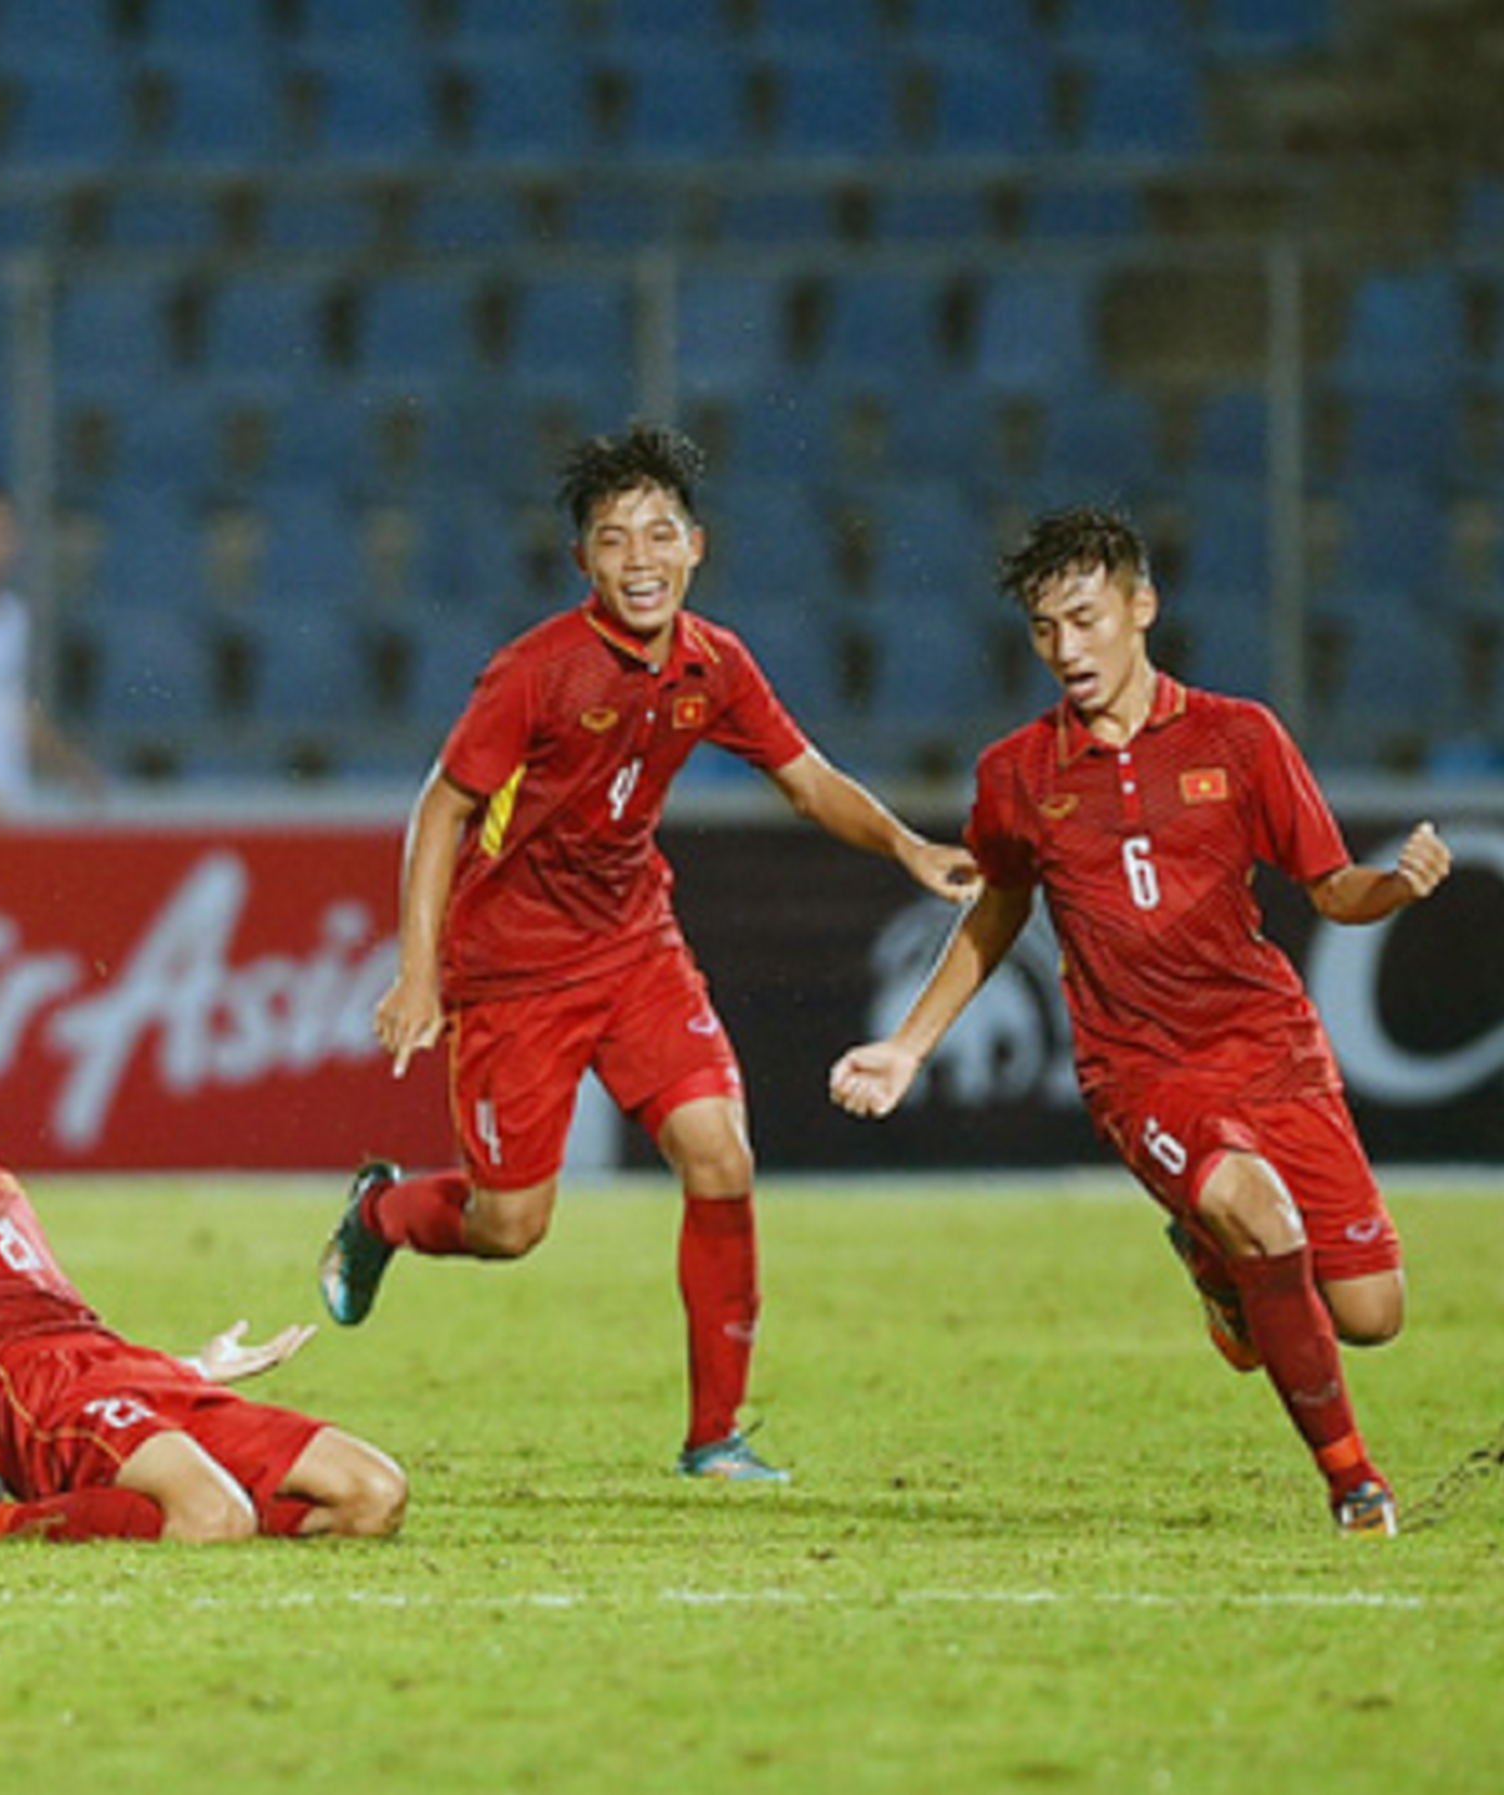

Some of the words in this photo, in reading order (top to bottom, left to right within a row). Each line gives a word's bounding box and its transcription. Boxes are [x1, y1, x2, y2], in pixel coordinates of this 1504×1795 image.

[607, 759, 641, 820] 4
[1121, 836, 1160, 909] 6
[475, 1100, 501, 1164] 4
[1143, 1115, 1186, 1175] 6
